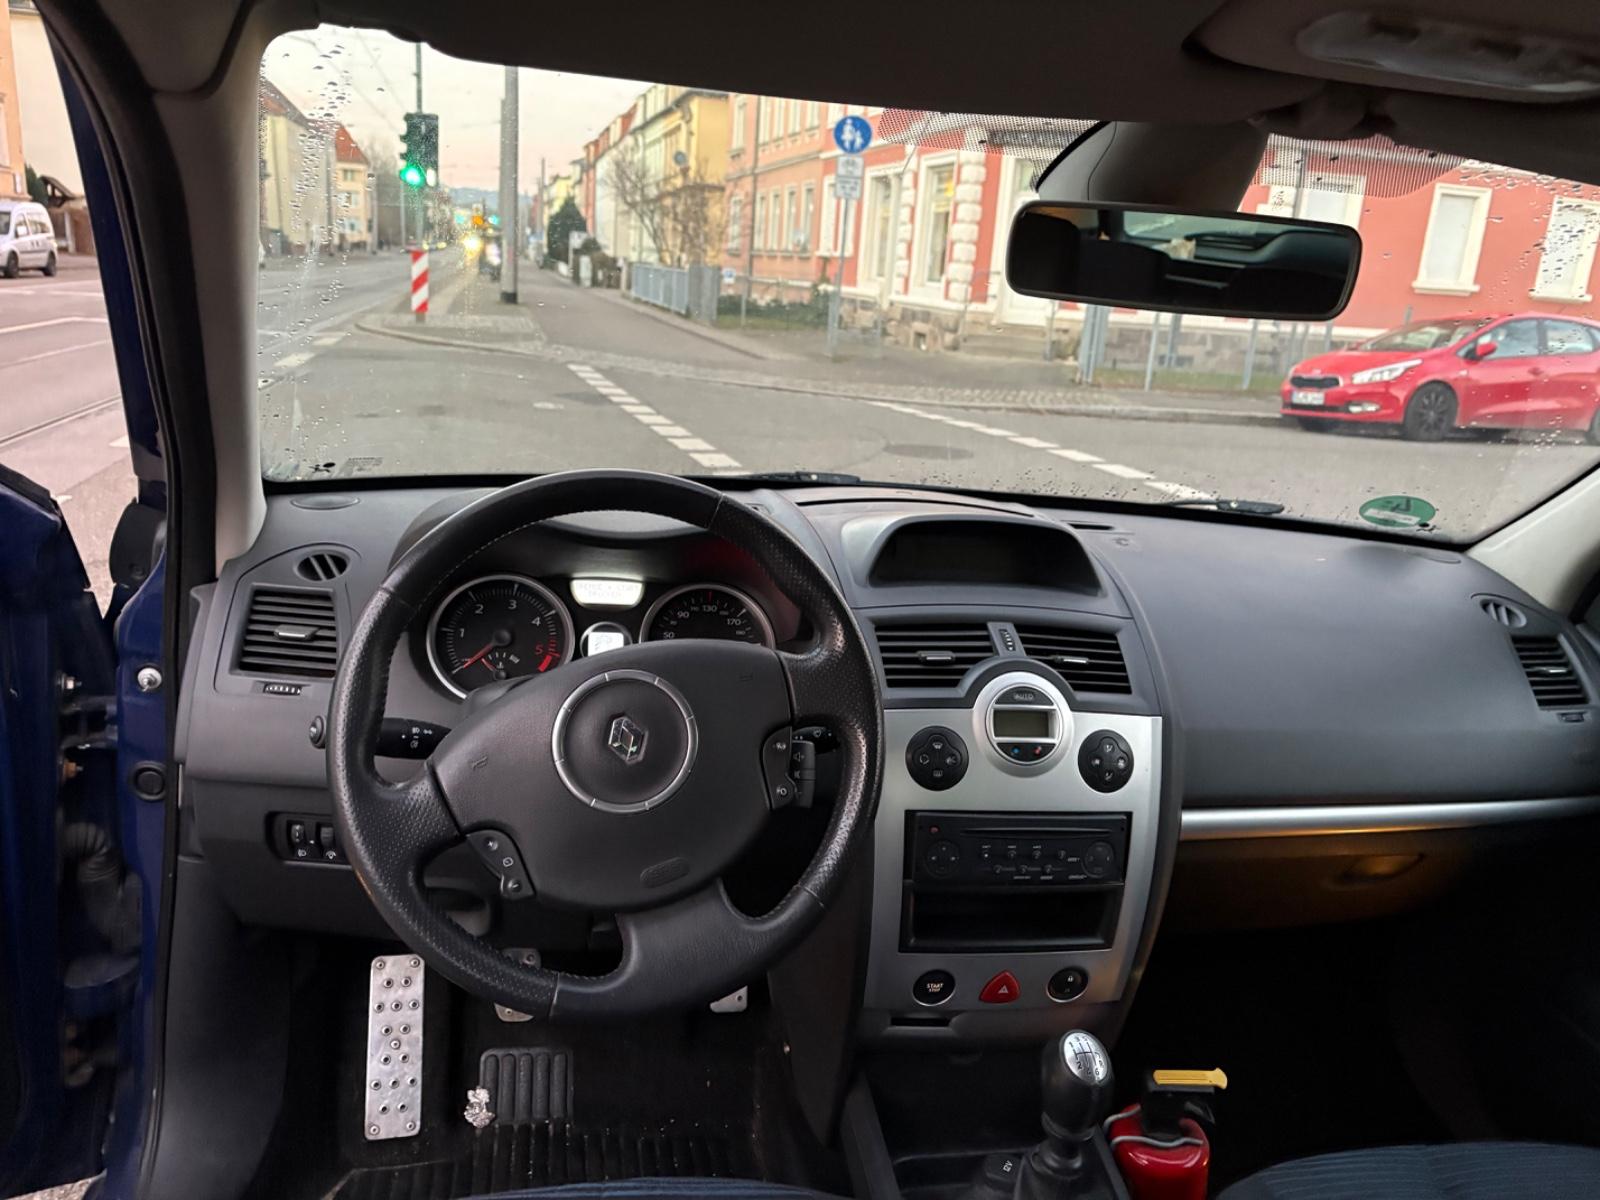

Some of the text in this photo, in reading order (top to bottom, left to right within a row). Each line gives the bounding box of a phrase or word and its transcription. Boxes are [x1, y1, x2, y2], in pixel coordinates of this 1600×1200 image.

[474, 604, 485, 615] 2
[508, 599, 518, 610] 3
[702, 604, 718, 613] 130
[677, 610, 690, 619] 90
[531, 616, 542, 627] 4
[727, 618, 742, 626] 170
[459, 628, 466, 639] 1
[535, 644, 544, 655] 5
[1076, 1061, 1083, 1070] 2
